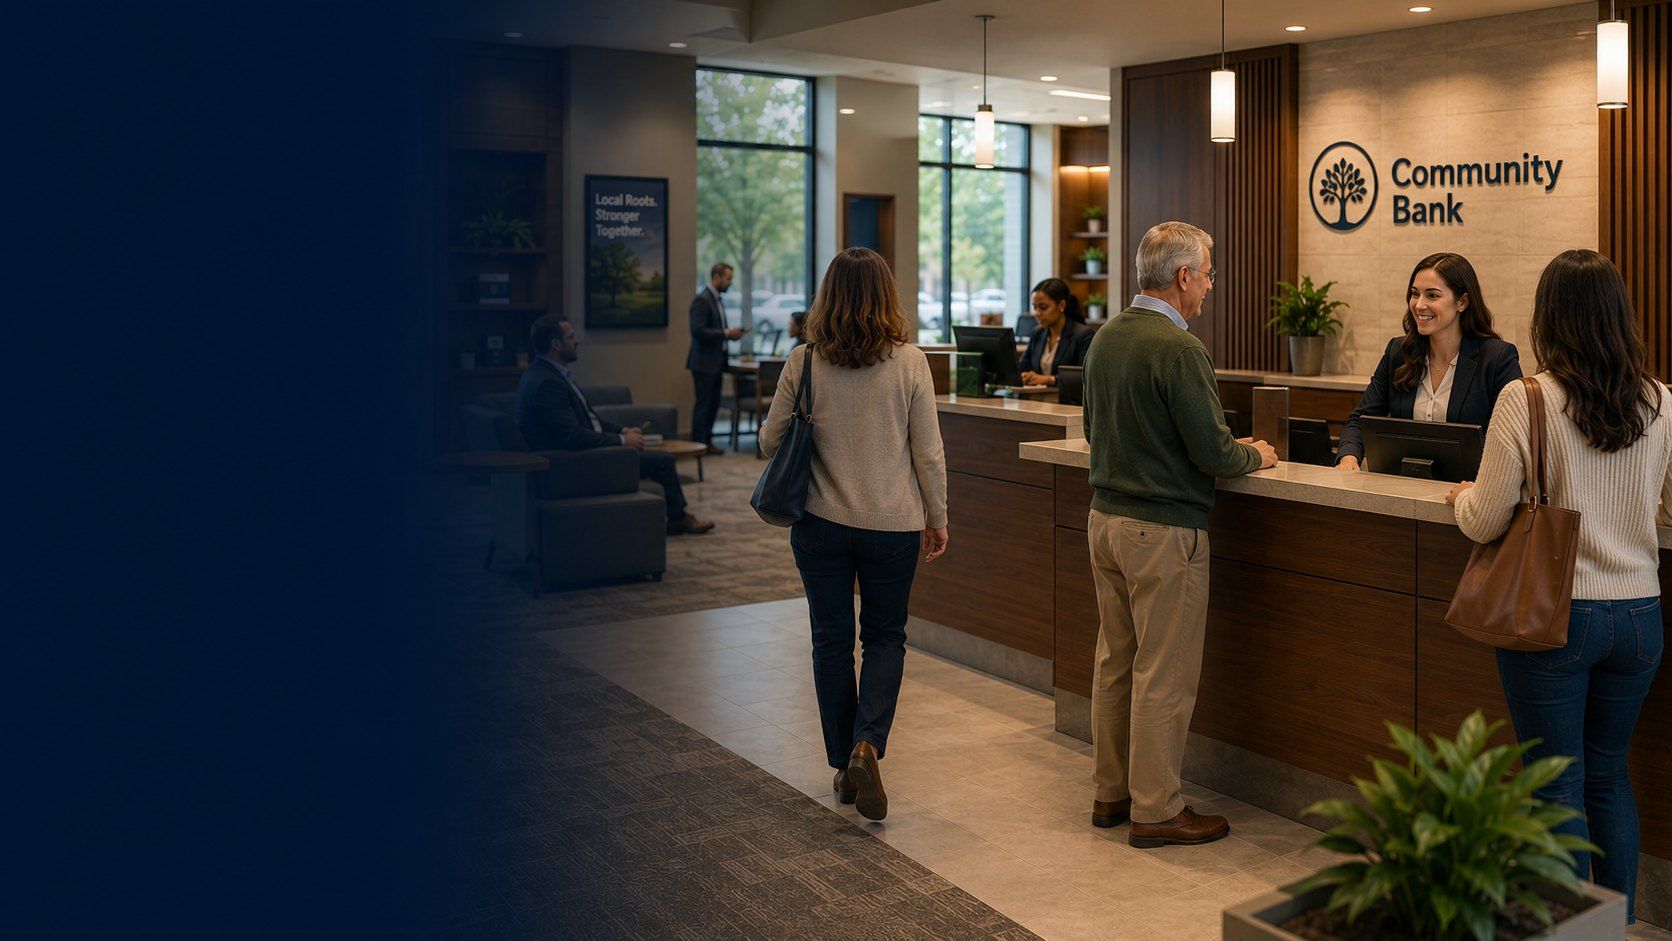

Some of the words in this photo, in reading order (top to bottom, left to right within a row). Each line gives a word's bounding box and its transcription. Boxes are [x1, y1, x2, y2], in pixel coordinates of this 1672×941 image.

[1391, 152, 1564, 192] Community
[595, 193, 624, 206] Local
[625, 194, 658, 207] Roots.
[595, 208, 640, 224] Stronger
[1393, 193, 1463, 224] Bank
[595, 224, 645, 239] Together.
